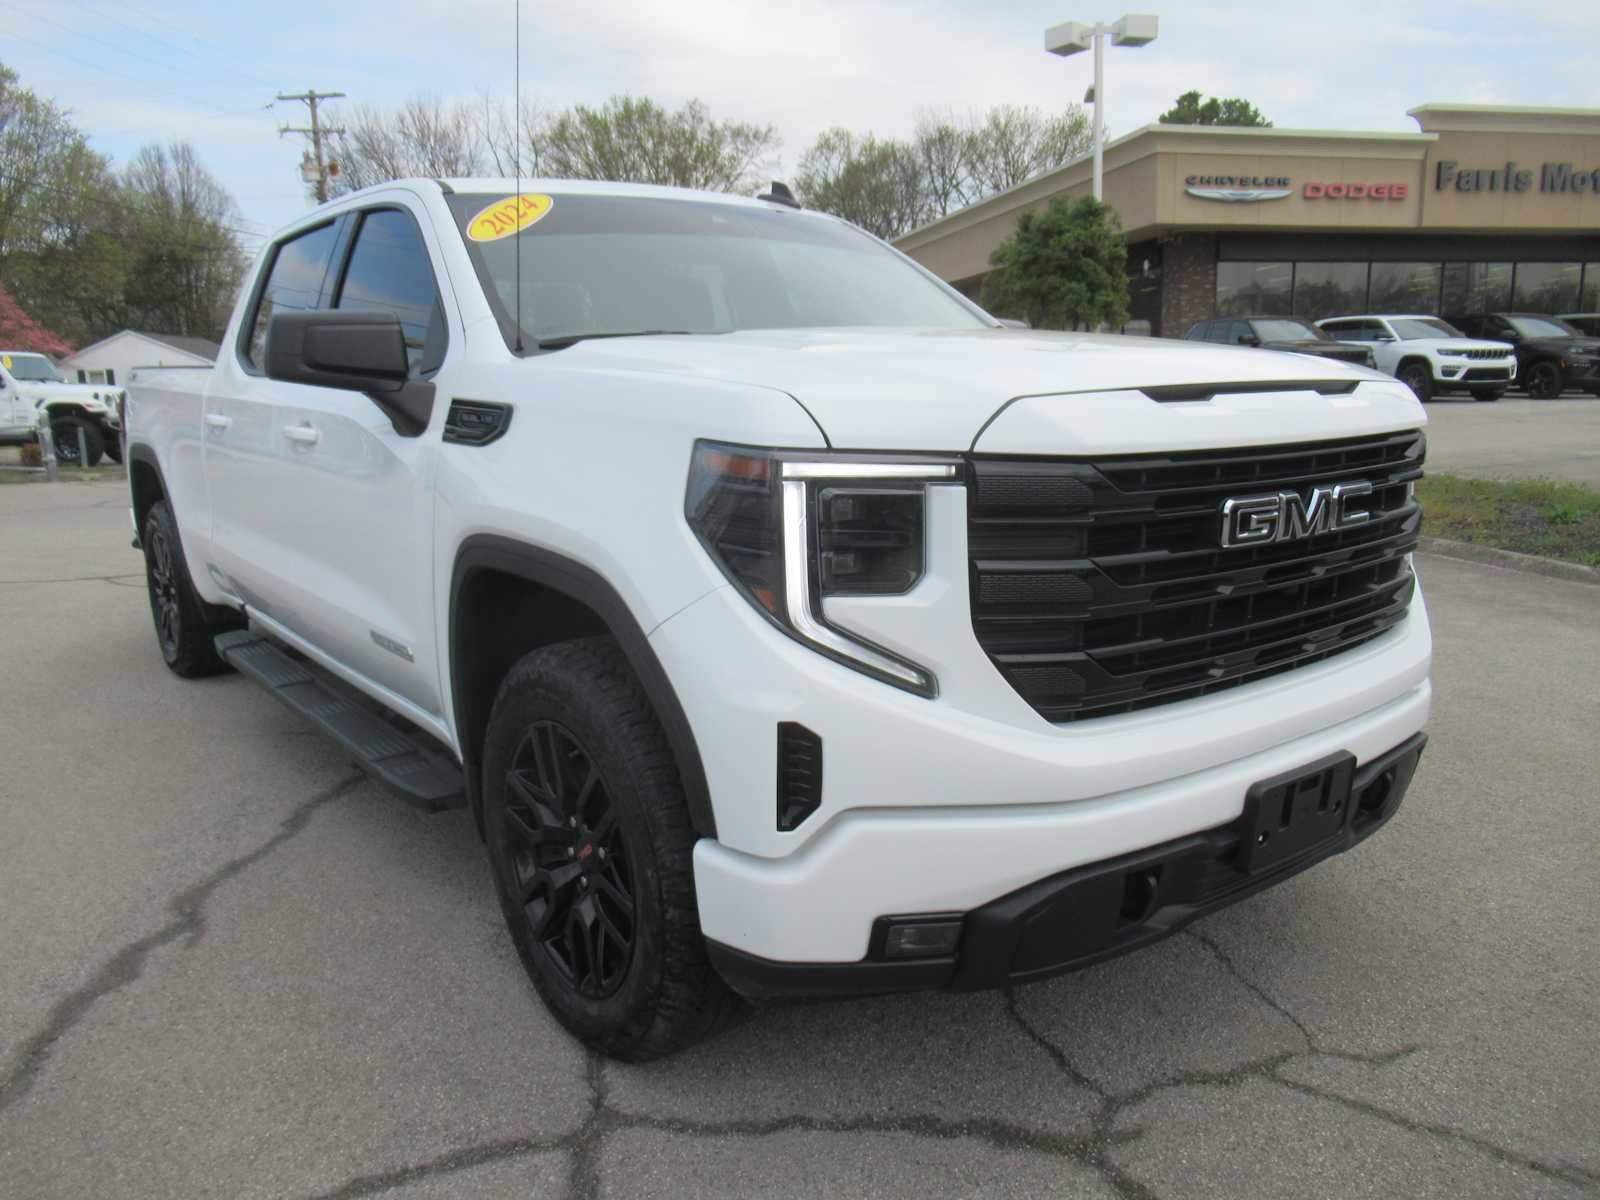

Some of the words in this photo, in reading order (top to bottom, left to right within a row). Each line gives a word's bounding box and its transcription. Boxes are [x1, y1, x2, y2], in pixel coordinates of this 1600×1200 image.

[1185, 175, 1291, 187] CHRYSLER
[1304, 182, 1408, 200] DODGE
[1436, 160, 1533, 192] Farris
[480, 196, 538, 235] 2024
[1221, 480, 1373, 548] GMC
